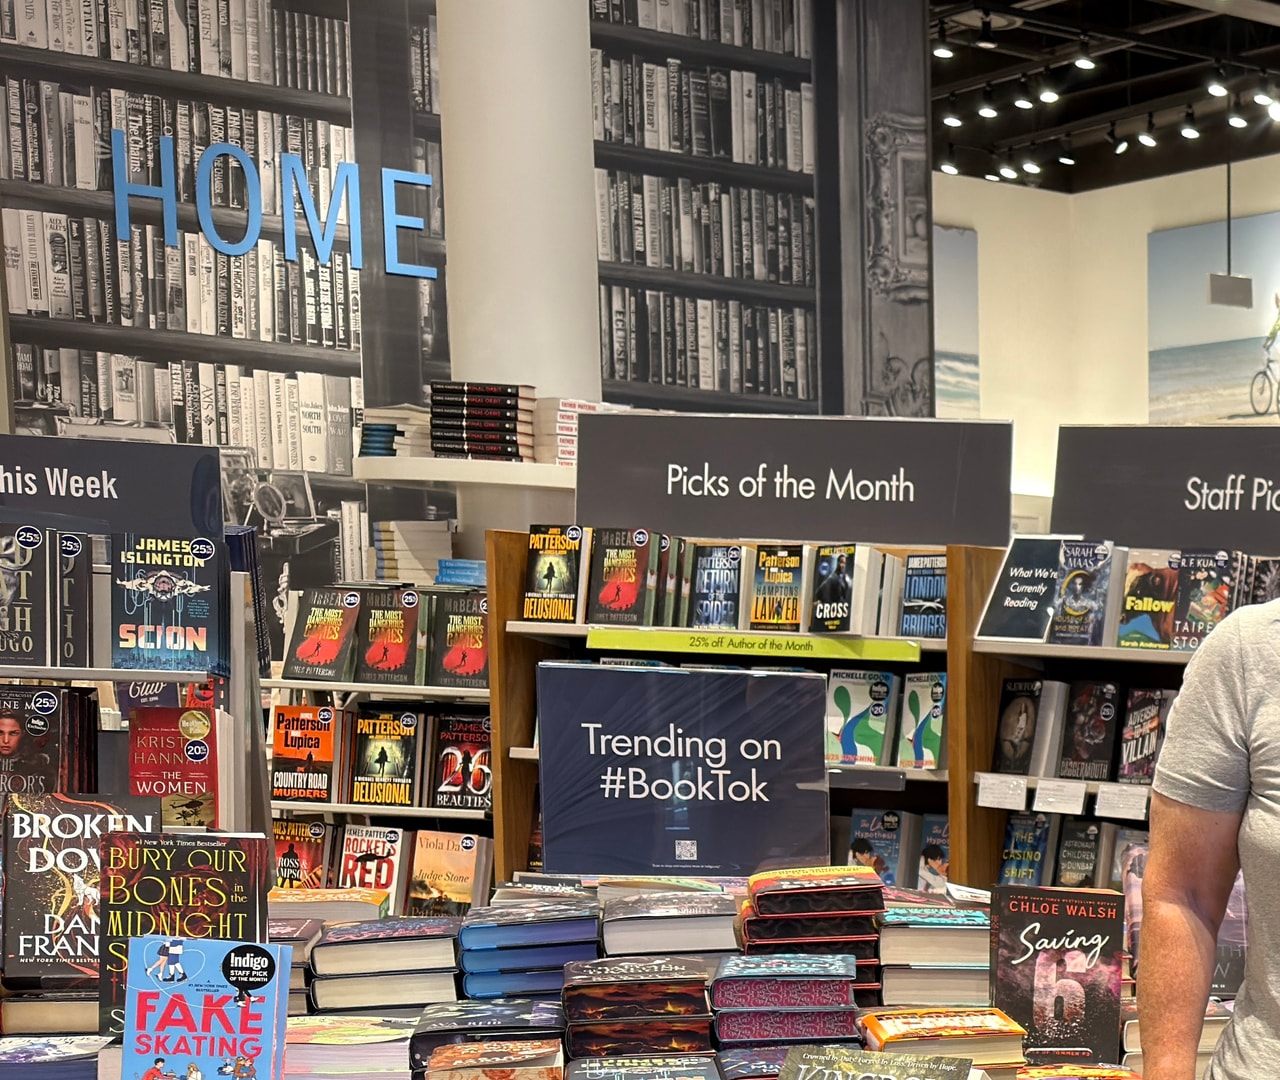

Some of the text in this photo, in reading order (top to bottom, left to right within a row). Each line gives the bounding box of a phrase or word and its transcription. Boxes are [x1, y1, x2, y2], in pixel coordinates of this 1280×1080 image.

[111, 129, 438, 279] HOME
[44, 467, 118, 499] Week
[667, 462, 914, 502] Picks of the Month
[1184, 474, 1246, 512] Staff
[135, 538, 190, 552] JAMES
[121, 551, 205, 568] ISLINGTON
[1009, 568, 1032, 578] What
[1010, 583, 1047, 596] Currently
[816, 601, 848, 620] CROSS
[1004, 597, 1038, 611] Reading
[1125, 596, 1175, 613] Fallow
[119, 624, 207, 651] SCION
[689, 637, 813, 651] 25% off Author of the Month
[284, 733, 320, 750] Lupica
[581, 722, 782, 765] Trending on
[136, 781, 206, 794] WOMEN
[274, 772, 327, 790] COUNTRY ROAD
[600, 767, 770, 803] #BookTok
[273, 788, 327, 799] MURDERS
[353, 783, 411, 804] DELUSIONAL
[437, 794, 491, 808] BEAUTIES
[13, 813, 152, 839] BROKEN
[109, 847, 247, 872] BURY OUR
[415, 869, 469, 883] Judge Stone
[108, 876, 226, 906] BONES
[234, 883, 243, 892] in
[230, 893, 247, 903] the
[1009, 900, 1117, 919] CHLOE WALSH
[107, 911, 247, 938] MIDNIGHT
[1011, 922, 1109, 969] Saving
[1033, 950, 1087, 1032] 6
[135, 991, 266, 1036] FAKE
[134, 1033, 263, 1058] SKATING
